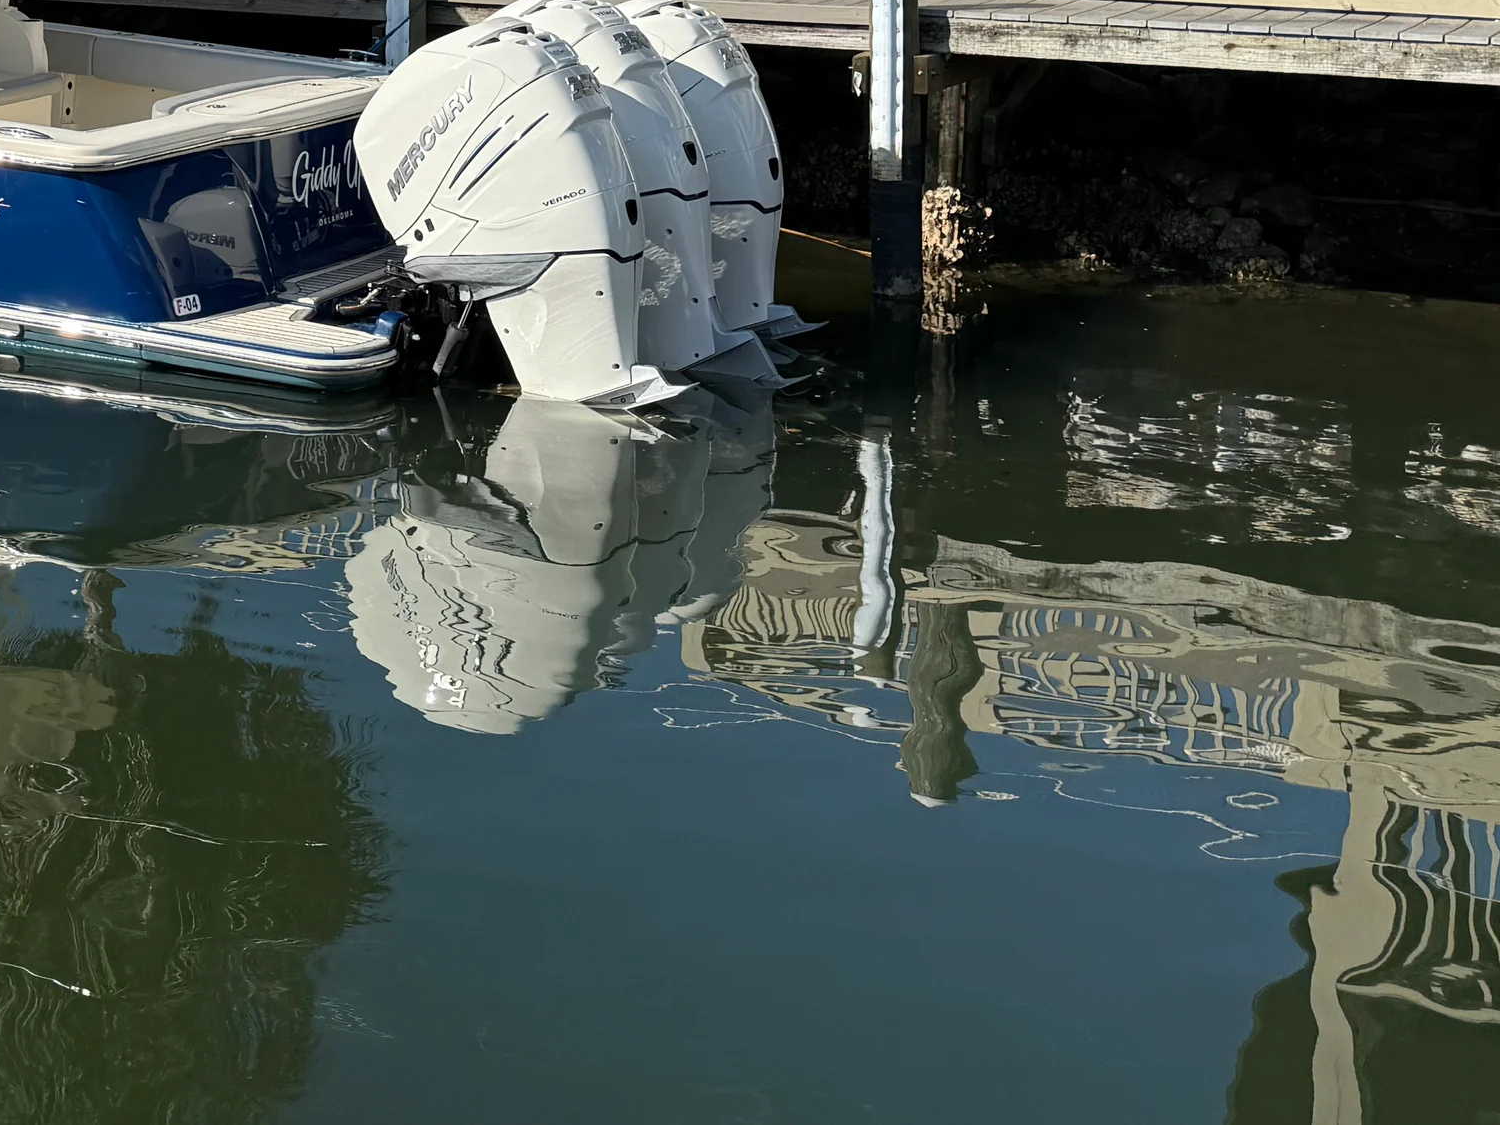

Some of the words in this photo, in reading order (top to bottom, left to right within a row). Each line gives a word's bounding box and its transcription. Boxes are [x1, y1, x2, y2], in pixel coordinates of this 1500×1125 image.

[387, 73, 473, 202] MERCURY
[292, 144, 341, 208] Giddy
[318, 209, 354, 227] OKLAHOMA
[542, 188, 586, 207] VERADO
